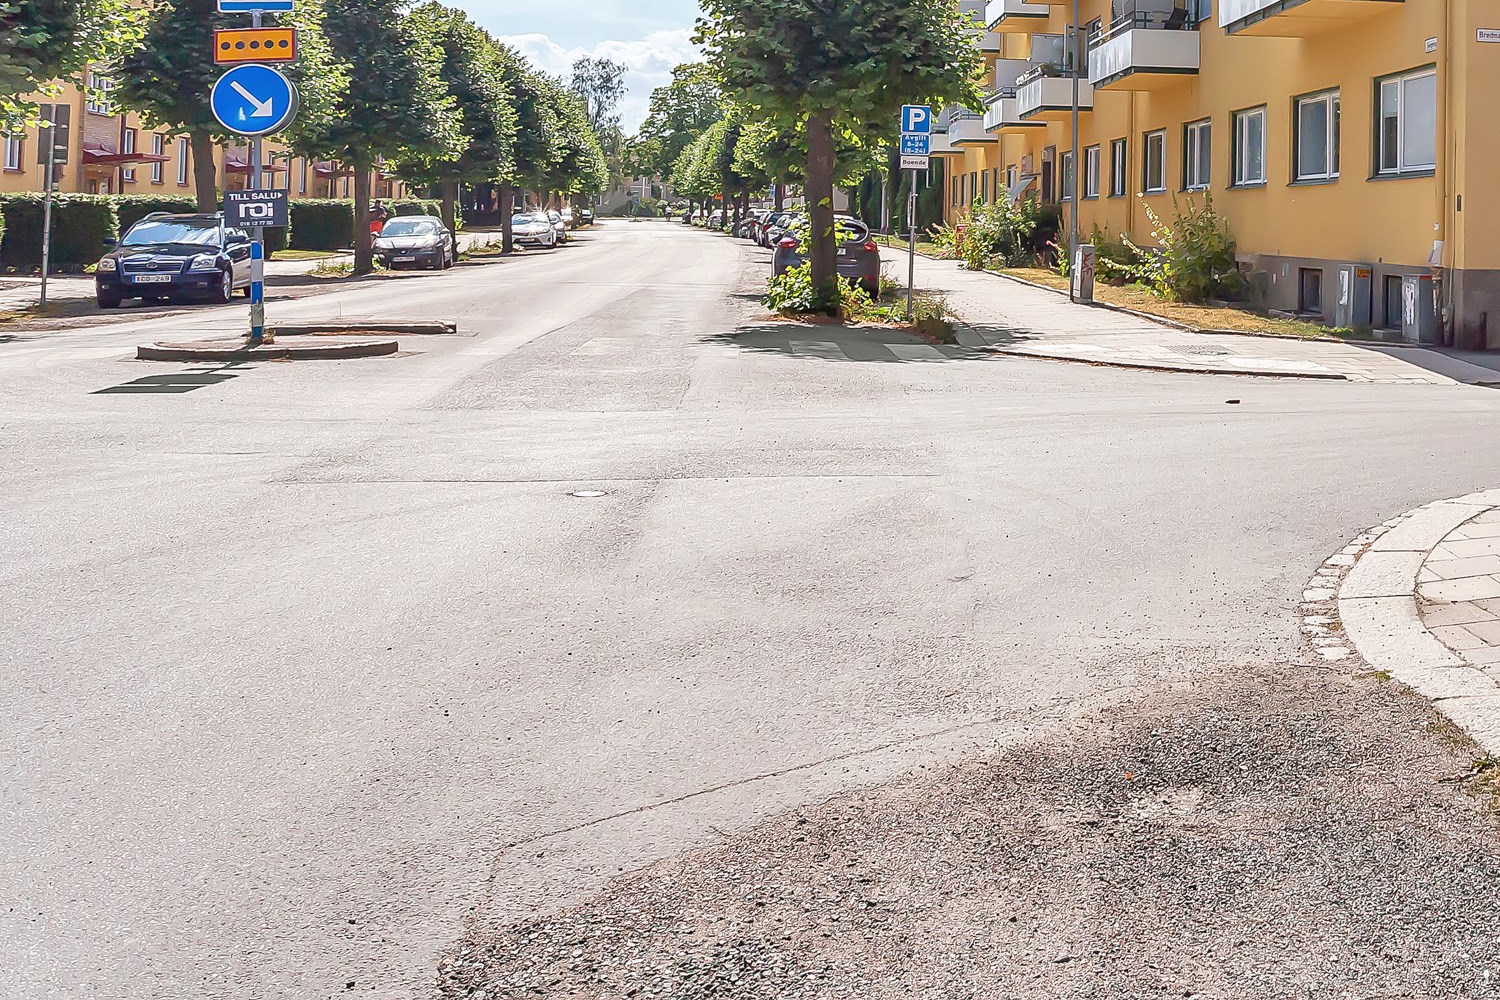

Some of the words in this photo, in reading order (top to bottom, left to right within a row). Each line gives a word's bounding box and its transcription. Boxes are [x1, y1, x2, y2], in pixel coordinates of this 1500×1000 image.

[909, 108, 926, 131] P
[229, 193, 250, 201] TILL
[251, 192, 277, 200] SALU
